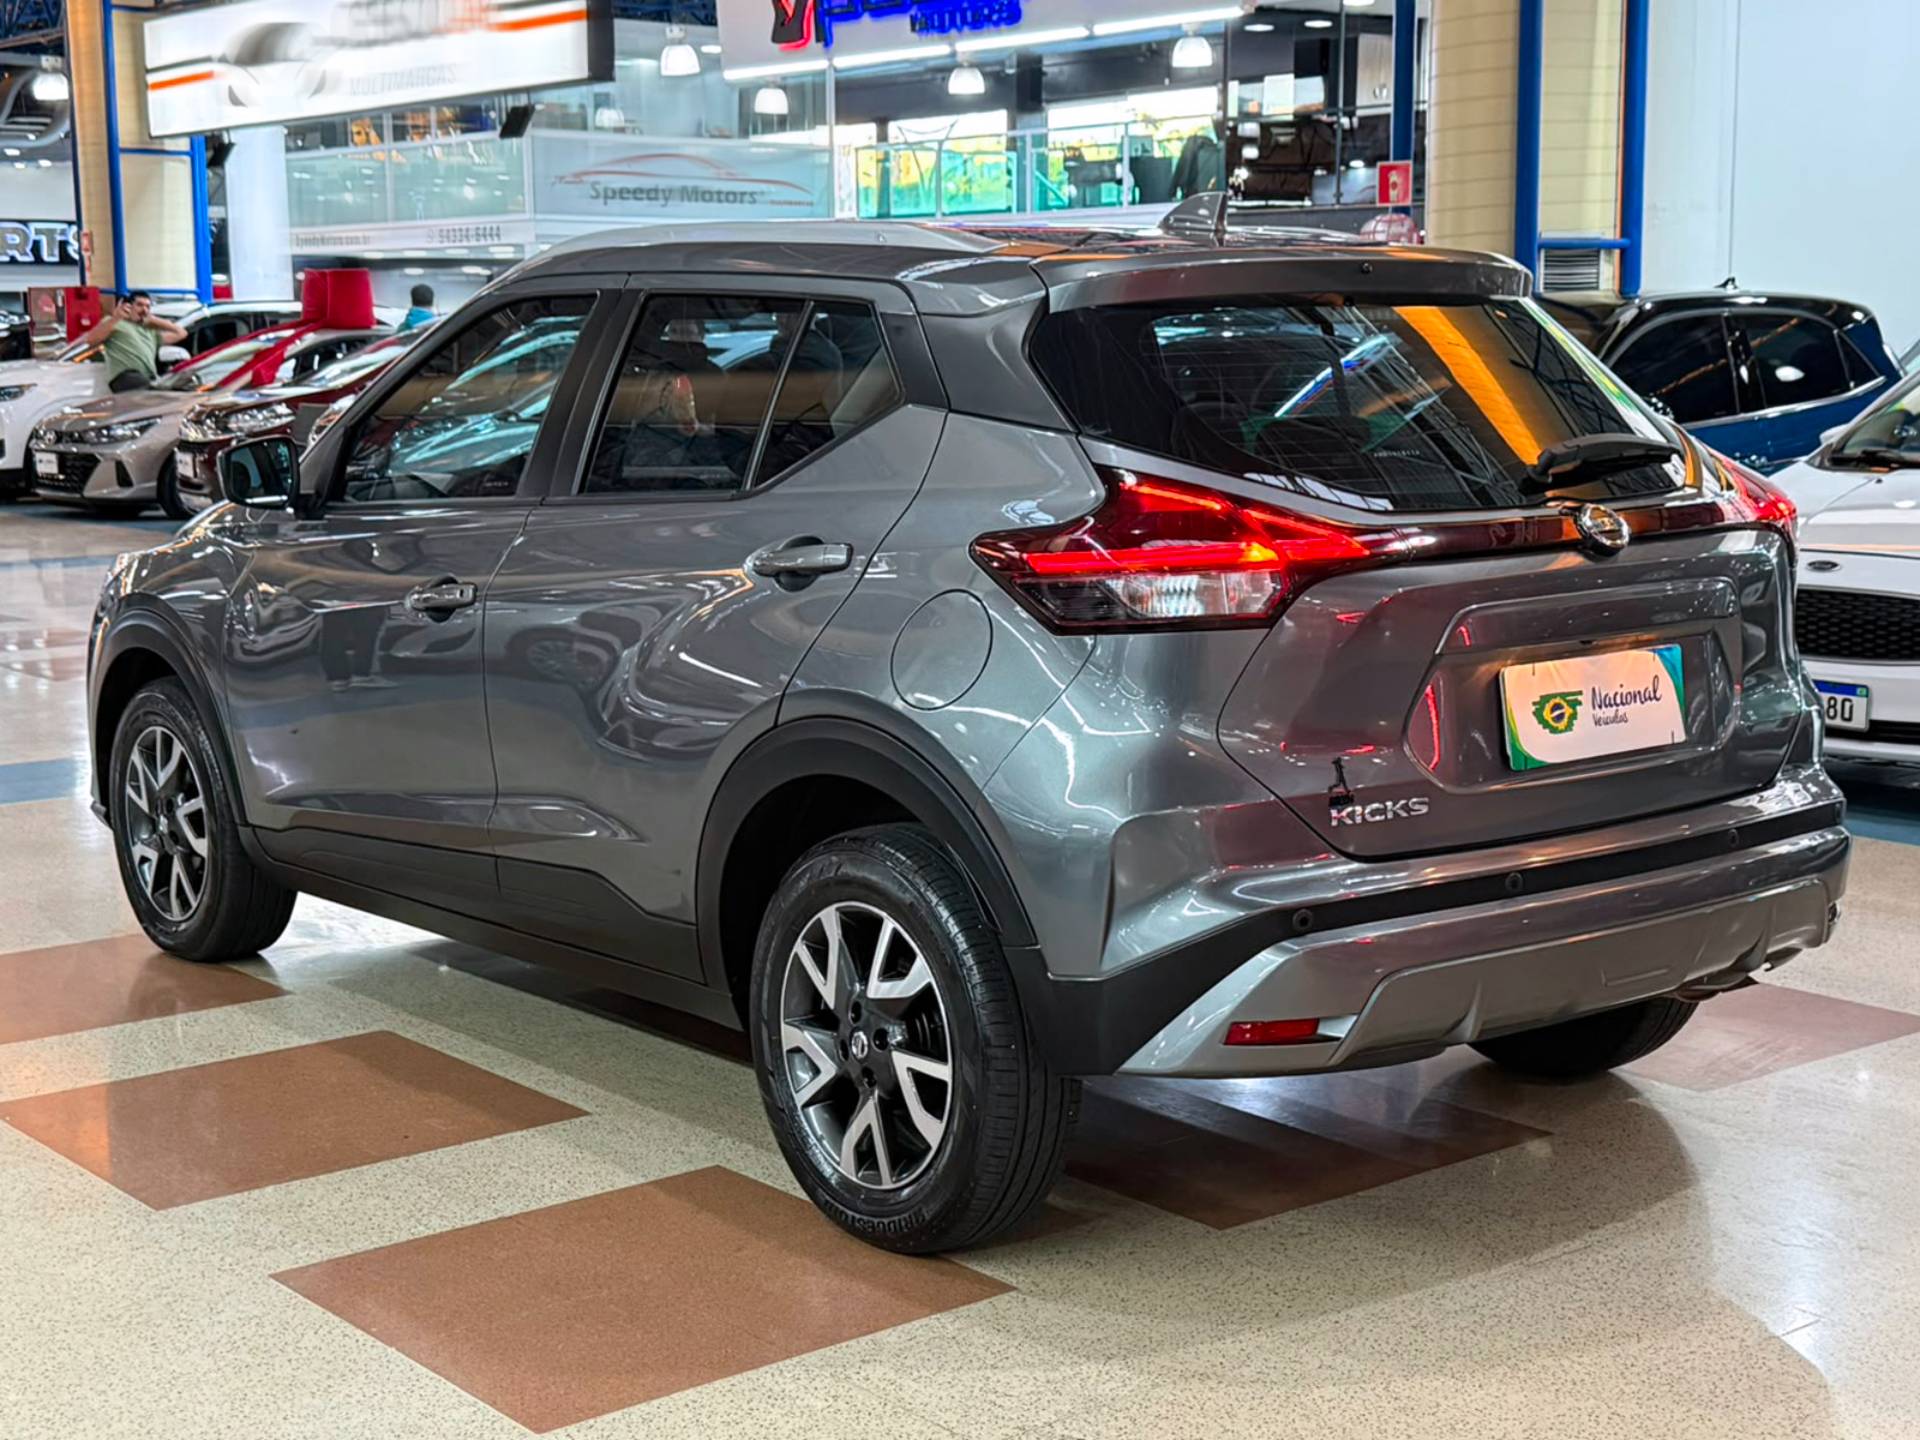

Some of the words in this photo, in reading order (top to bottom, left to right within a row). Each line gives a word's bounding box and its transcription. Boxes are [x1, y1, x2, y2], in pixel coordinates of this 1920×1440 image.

[590, 181, 673, 207] Speedy
[680, 184, 758, 205] Motors
[1591, 674, 1663, 711] Nacional
[1826, 695, 1854, 723] 80
[1330, 797, 1430, 827] KICKS
